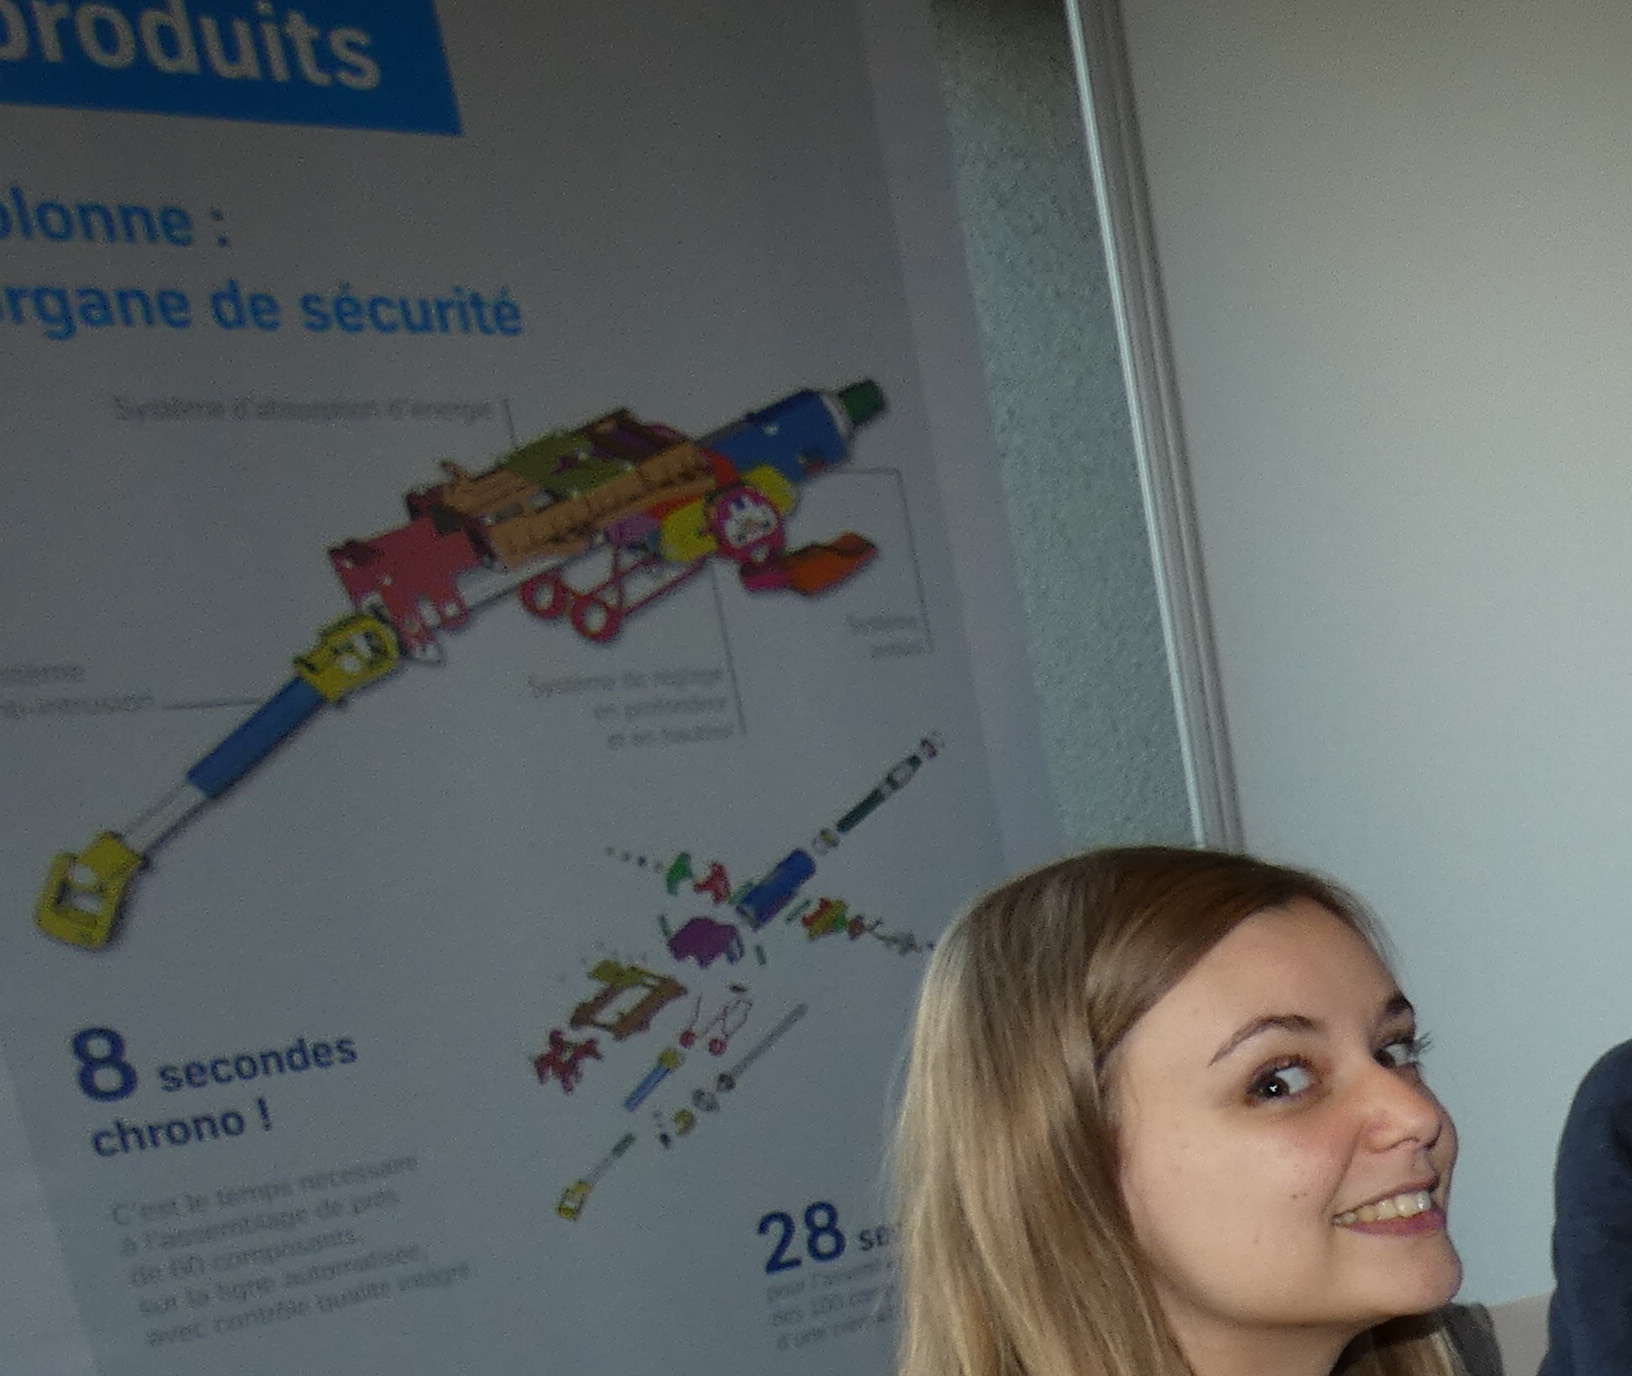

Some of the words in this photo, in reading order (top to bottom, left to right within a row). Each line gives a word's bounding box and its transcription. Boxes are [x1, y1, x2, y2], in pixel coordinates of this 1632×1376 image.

[0, 283, 194, 341] rgane
[209, 277, 281, 331] de
[302, 282, 524, 337] sécurité
[69, 1023, 140, 1103] 8
[156, 1033, 359, 1094] secondes
[90, 1105, 247, 1158] chrono
[256, 1094, 273, 1133] !
[755, 1199, 847, 1276] 28
